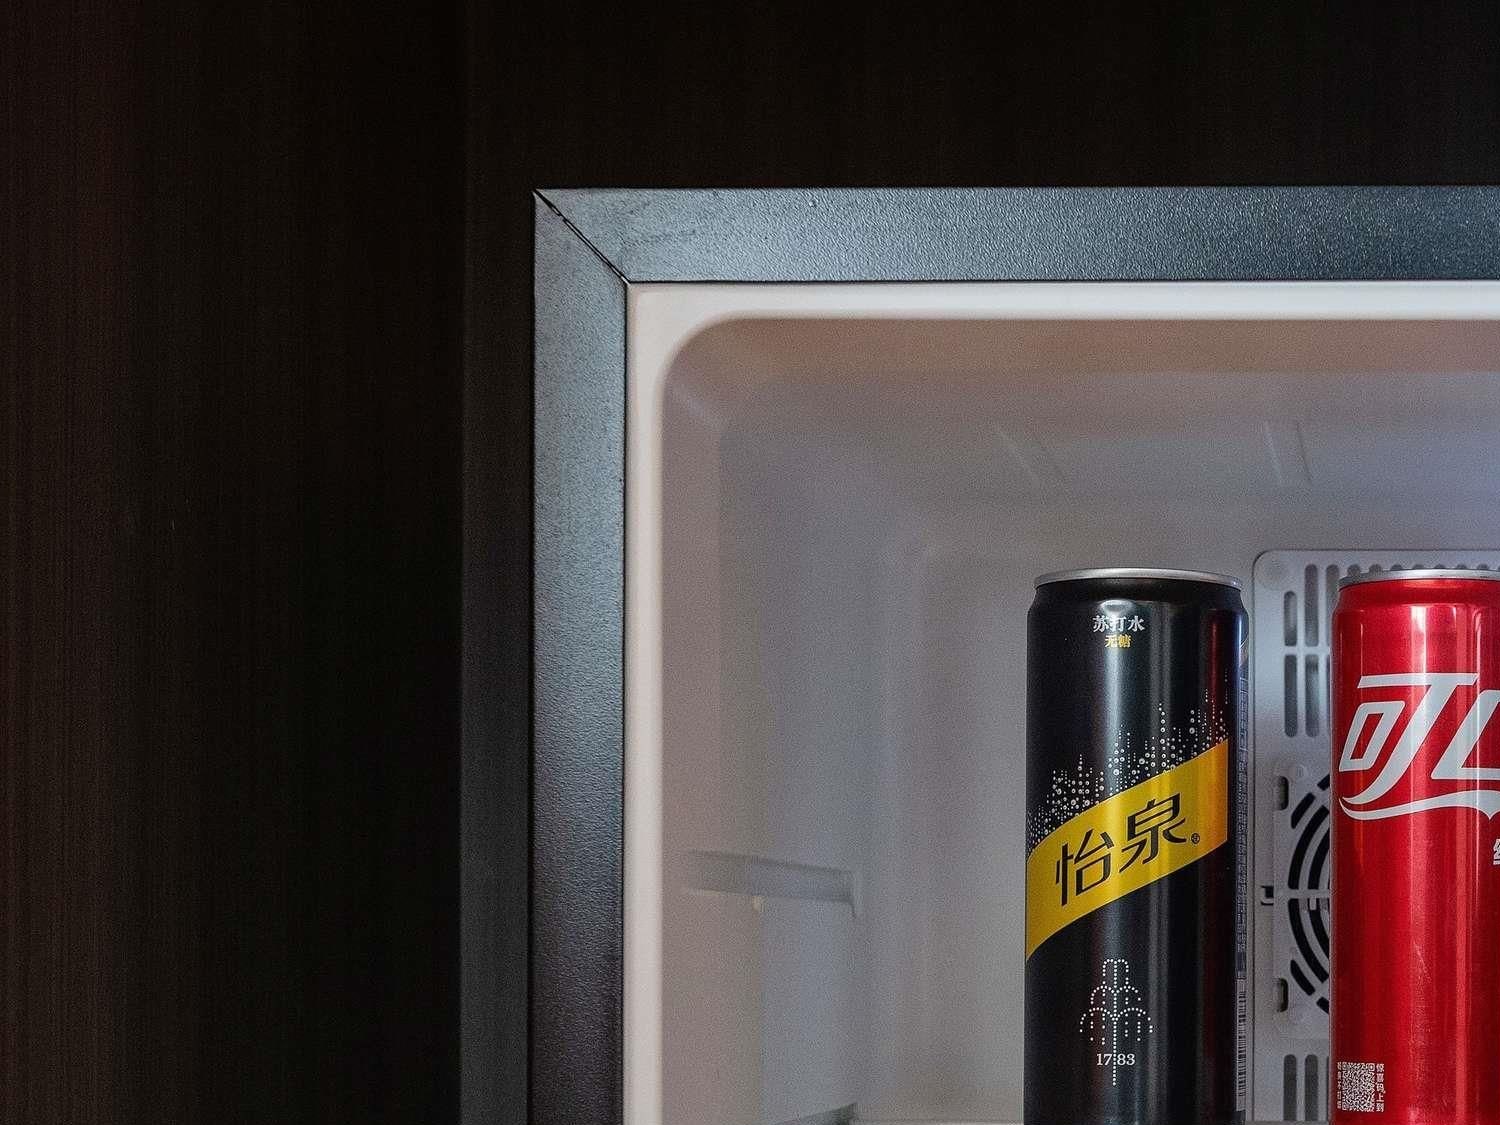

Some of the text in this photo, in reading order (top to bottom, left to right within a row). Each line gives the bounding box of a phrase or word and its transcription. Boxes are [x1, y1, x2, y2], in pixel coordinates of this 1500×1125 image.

[1092, 615, 1146, 633] 苏打水
[1104, 634, 1132, 648] 无糖
[1056, 792, 1188, 906] 怡泉
[1096, 1053, 1136, 1066] 1783
